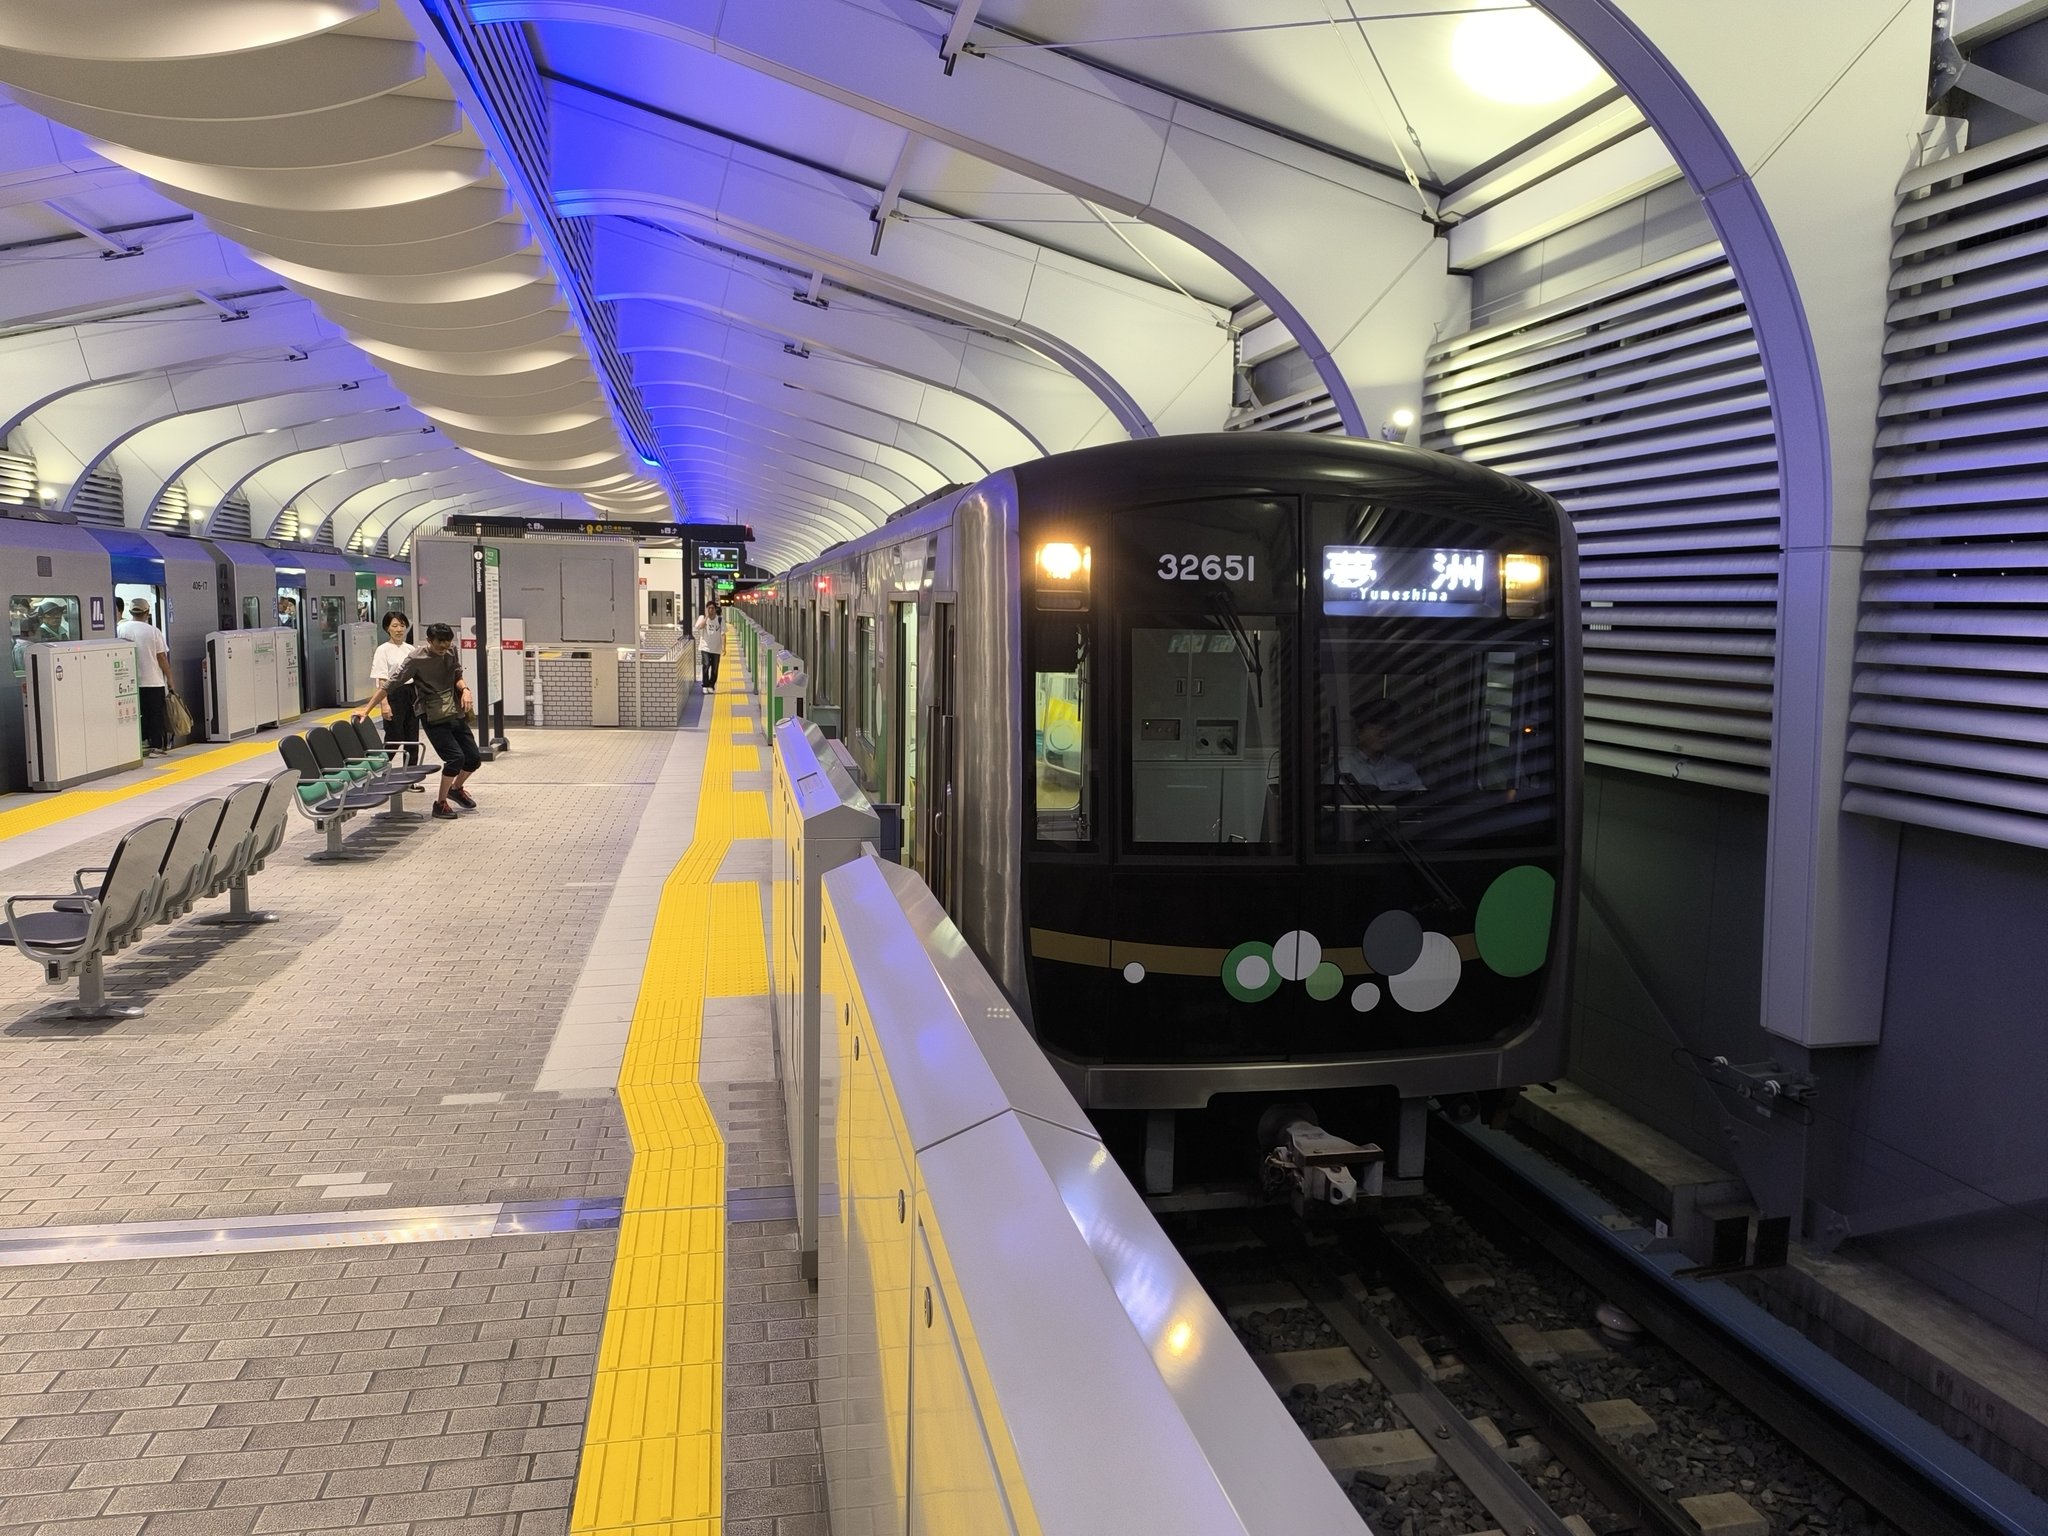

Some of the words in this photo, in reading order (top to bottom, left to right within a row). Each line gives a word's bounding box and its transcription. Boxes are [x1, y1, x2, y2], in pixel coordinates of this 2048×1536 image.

[475, 561, 483, 593] Information
[1157, 553, 1255, 582] 32651
[1359, 587, 1448, 602] Yumeshima
